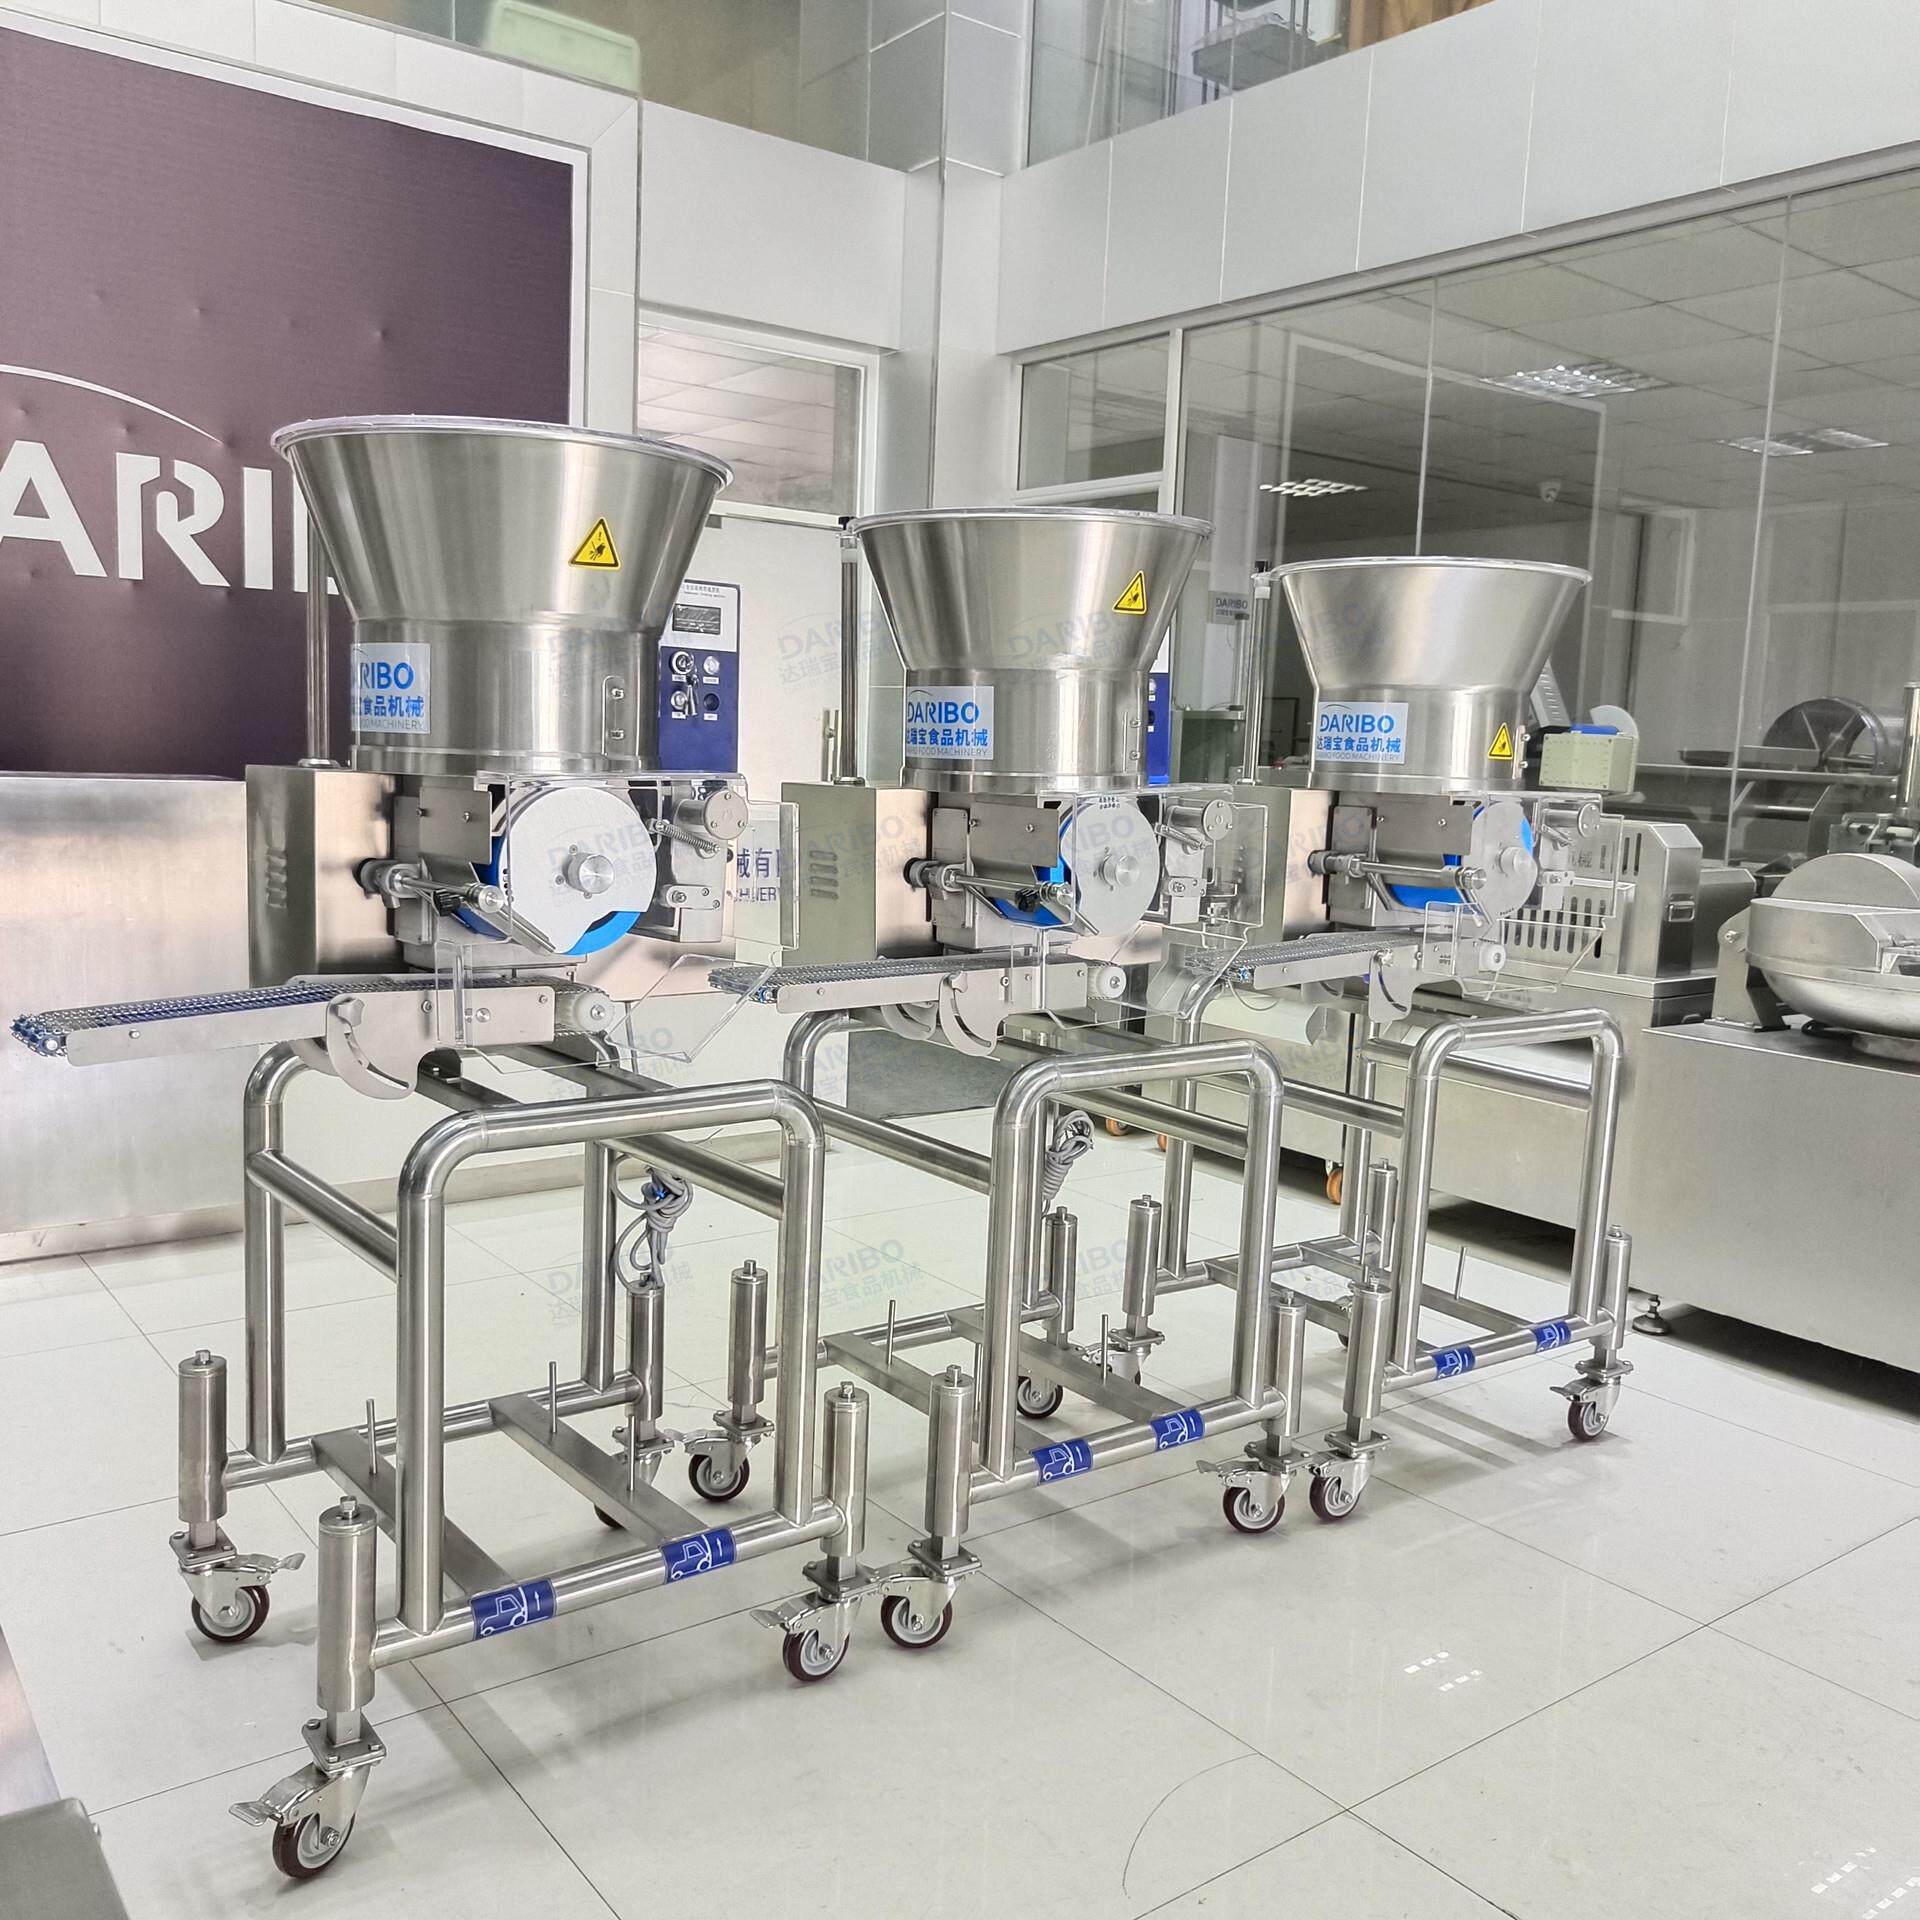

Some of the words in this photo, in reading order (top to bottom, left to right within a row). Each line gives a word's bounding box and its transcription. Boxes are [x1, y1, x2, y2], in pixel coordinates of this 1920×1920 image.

[0, 440, 340, 595] ARI
[360, 661, 414, 690] RIBO
[358, 694, 425, 718] 食品机械
[907, 701, 979, 724] DARIBO
[1320, 714, 1395, 734] DARIBO
